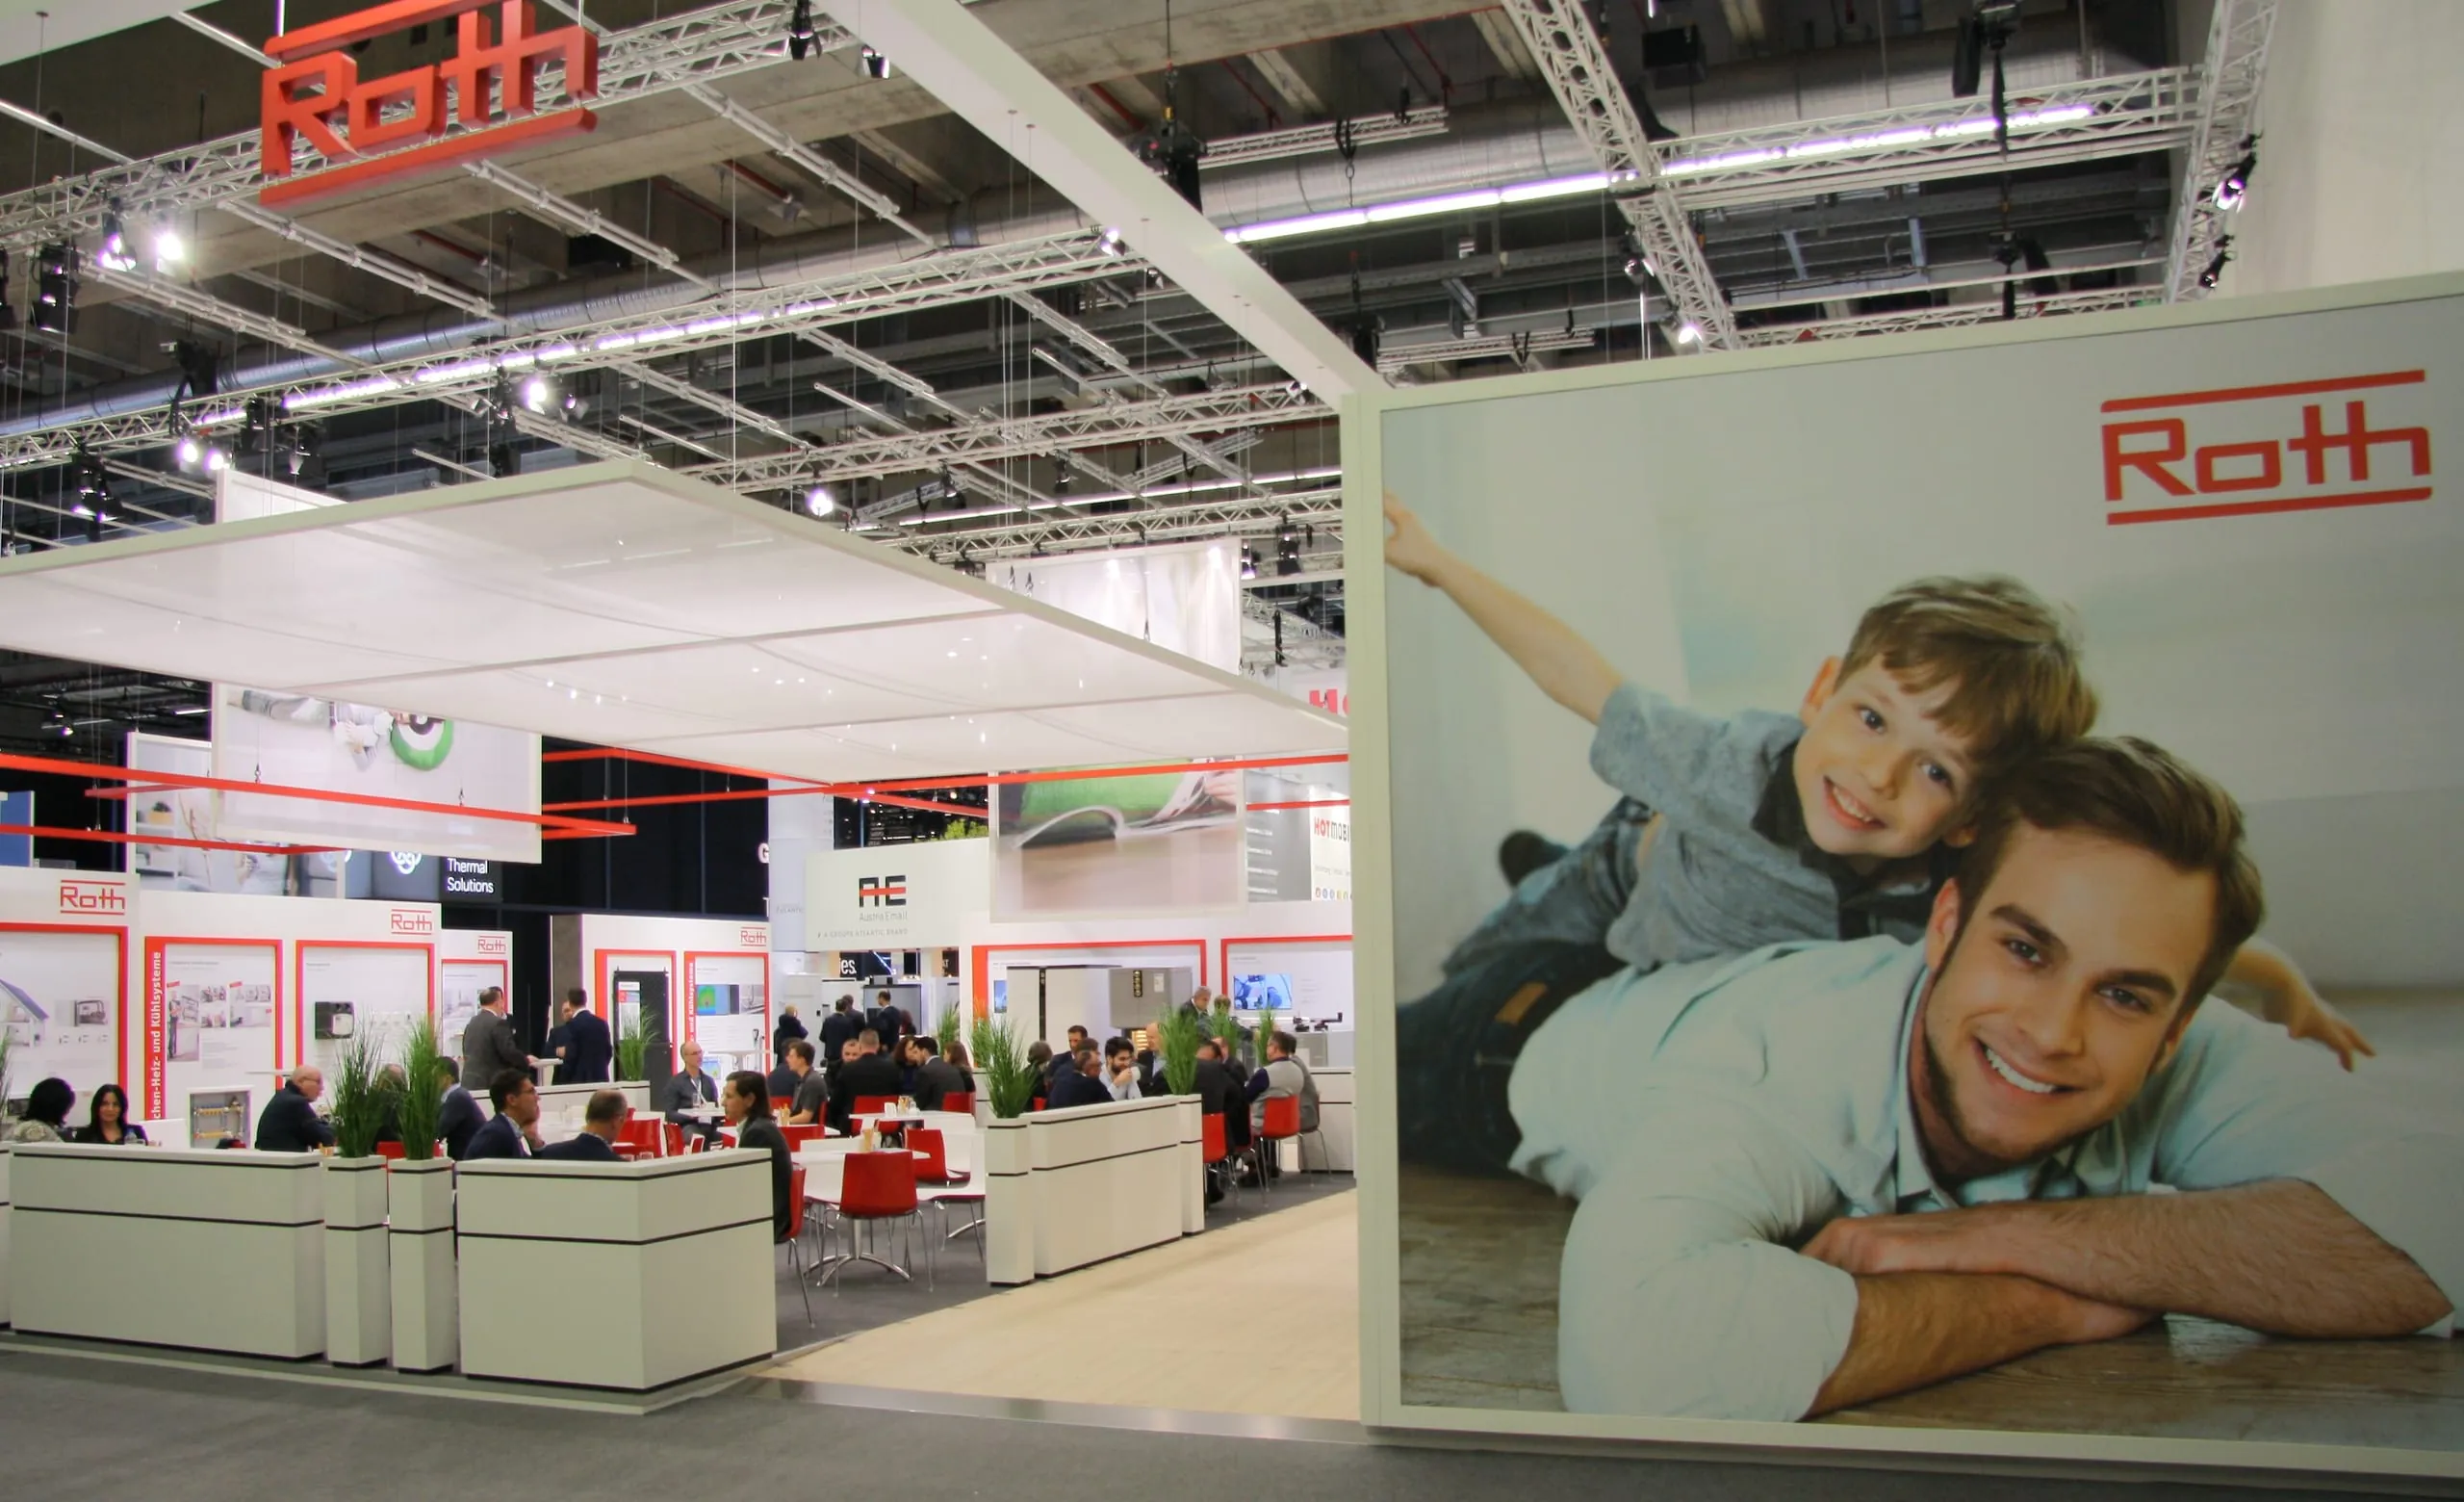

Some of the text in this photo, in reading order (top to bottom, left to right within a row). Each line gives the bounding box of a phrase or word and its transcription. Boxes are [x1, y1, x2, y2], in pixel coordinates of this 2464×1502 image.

[261, 0, 598, 176] Roth
[2101, 401, 2432, 502] Roth
[448, 858, 488, 874] Thermal
[448, 877, 494, 893] Solutions
[60, 886, 125, 910] Roth
[391, 914, 432, 931] Roth
[477, 939, 506, 952] Roth
[740, 930, 767, 945] Roth
[151, 951, 163, 1027] Kühlsysteme
[151, 1030, 162, 1052] und
